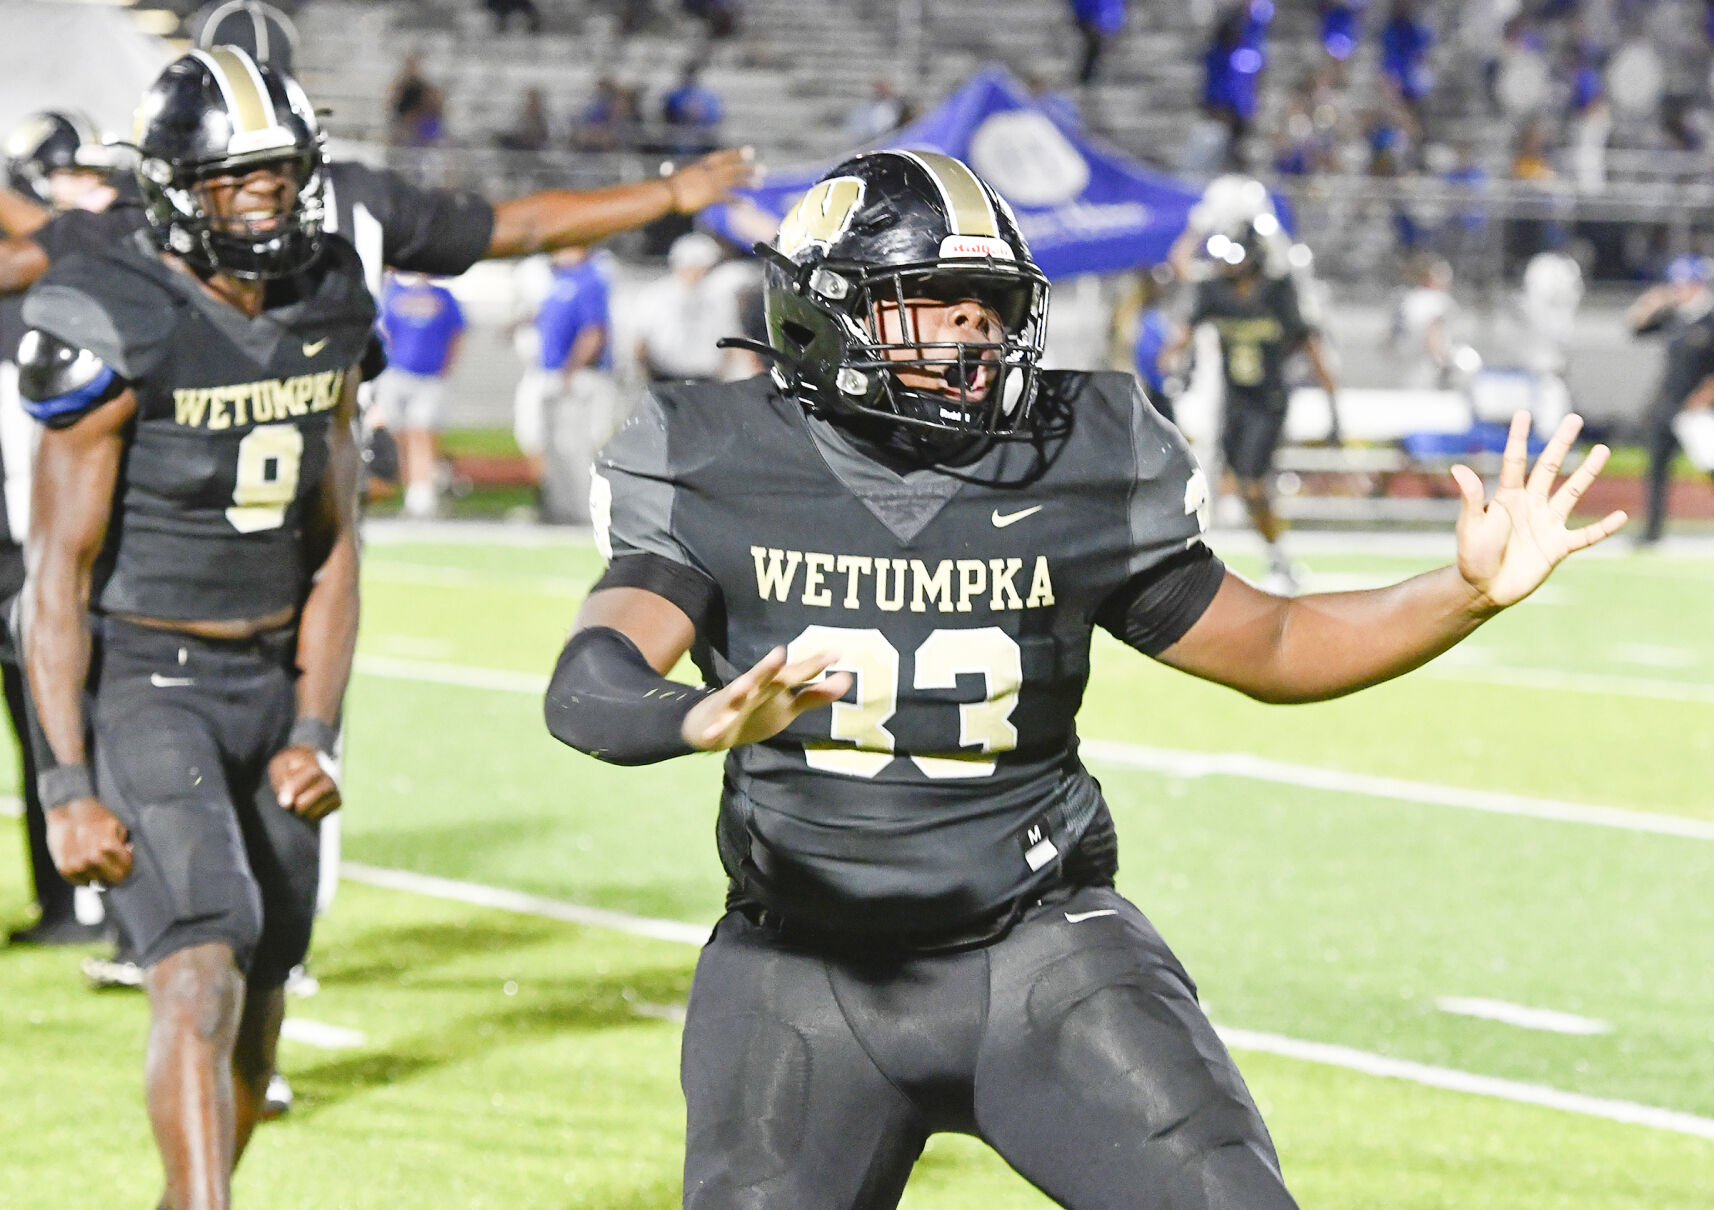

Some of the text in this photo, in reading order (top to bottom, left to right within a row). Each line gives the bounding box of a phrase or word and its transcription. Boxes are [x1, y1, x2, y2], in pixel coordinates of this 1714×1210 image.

[750, 546, 1055, 612] WETUMPKA
[786, 624, 1022, 779] 33
[1027, 824, 1042, 846] M
